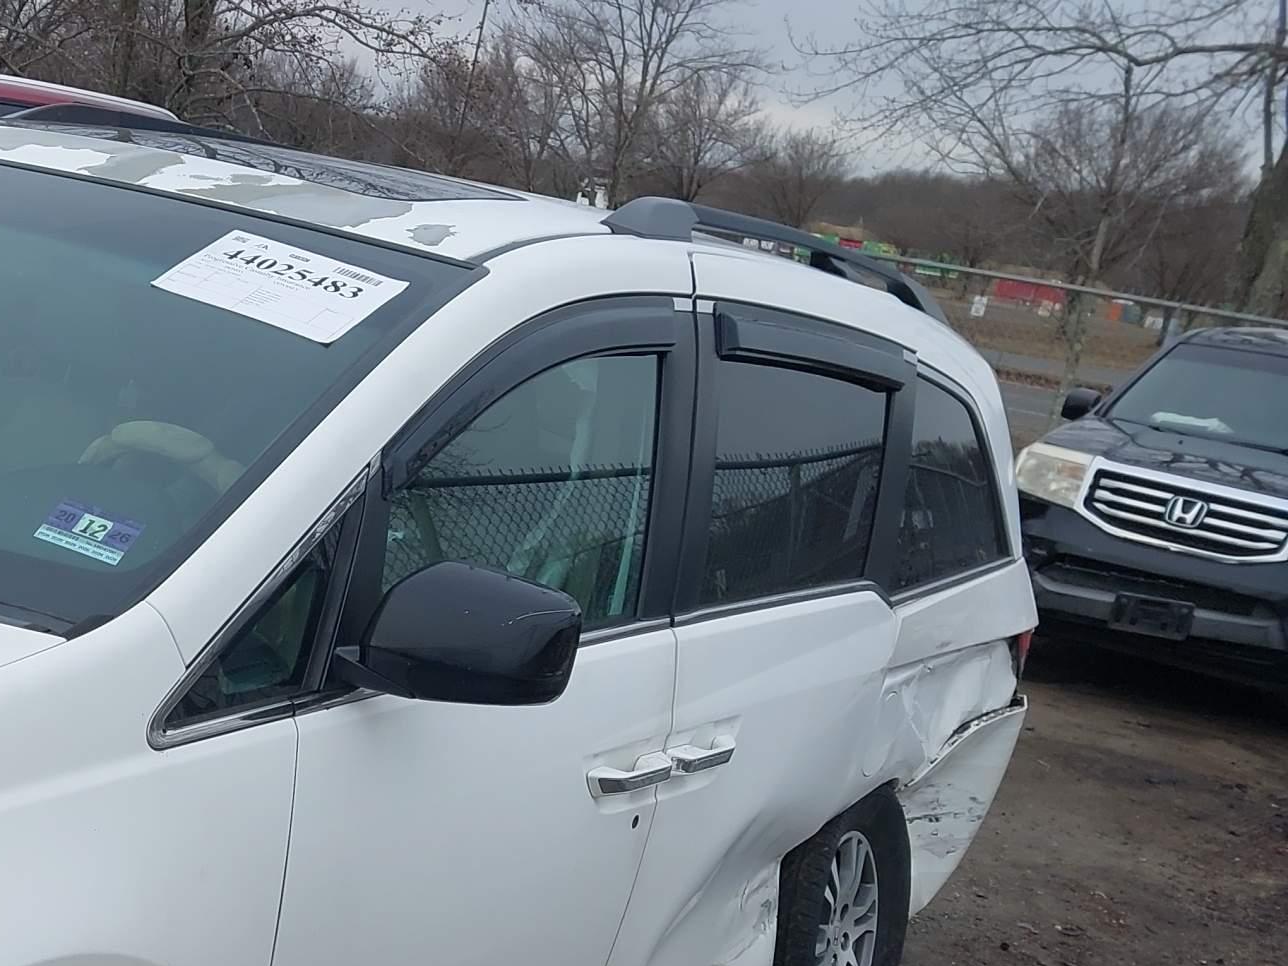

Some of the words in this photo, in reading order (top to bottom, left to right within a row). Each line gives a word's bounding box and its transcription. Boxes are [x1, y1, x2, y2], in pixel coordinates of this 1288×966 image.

[223, 248, 364, 300] 44025483
[56, 510, 76, 524] 20
[79, 519, 109, 539] 12
